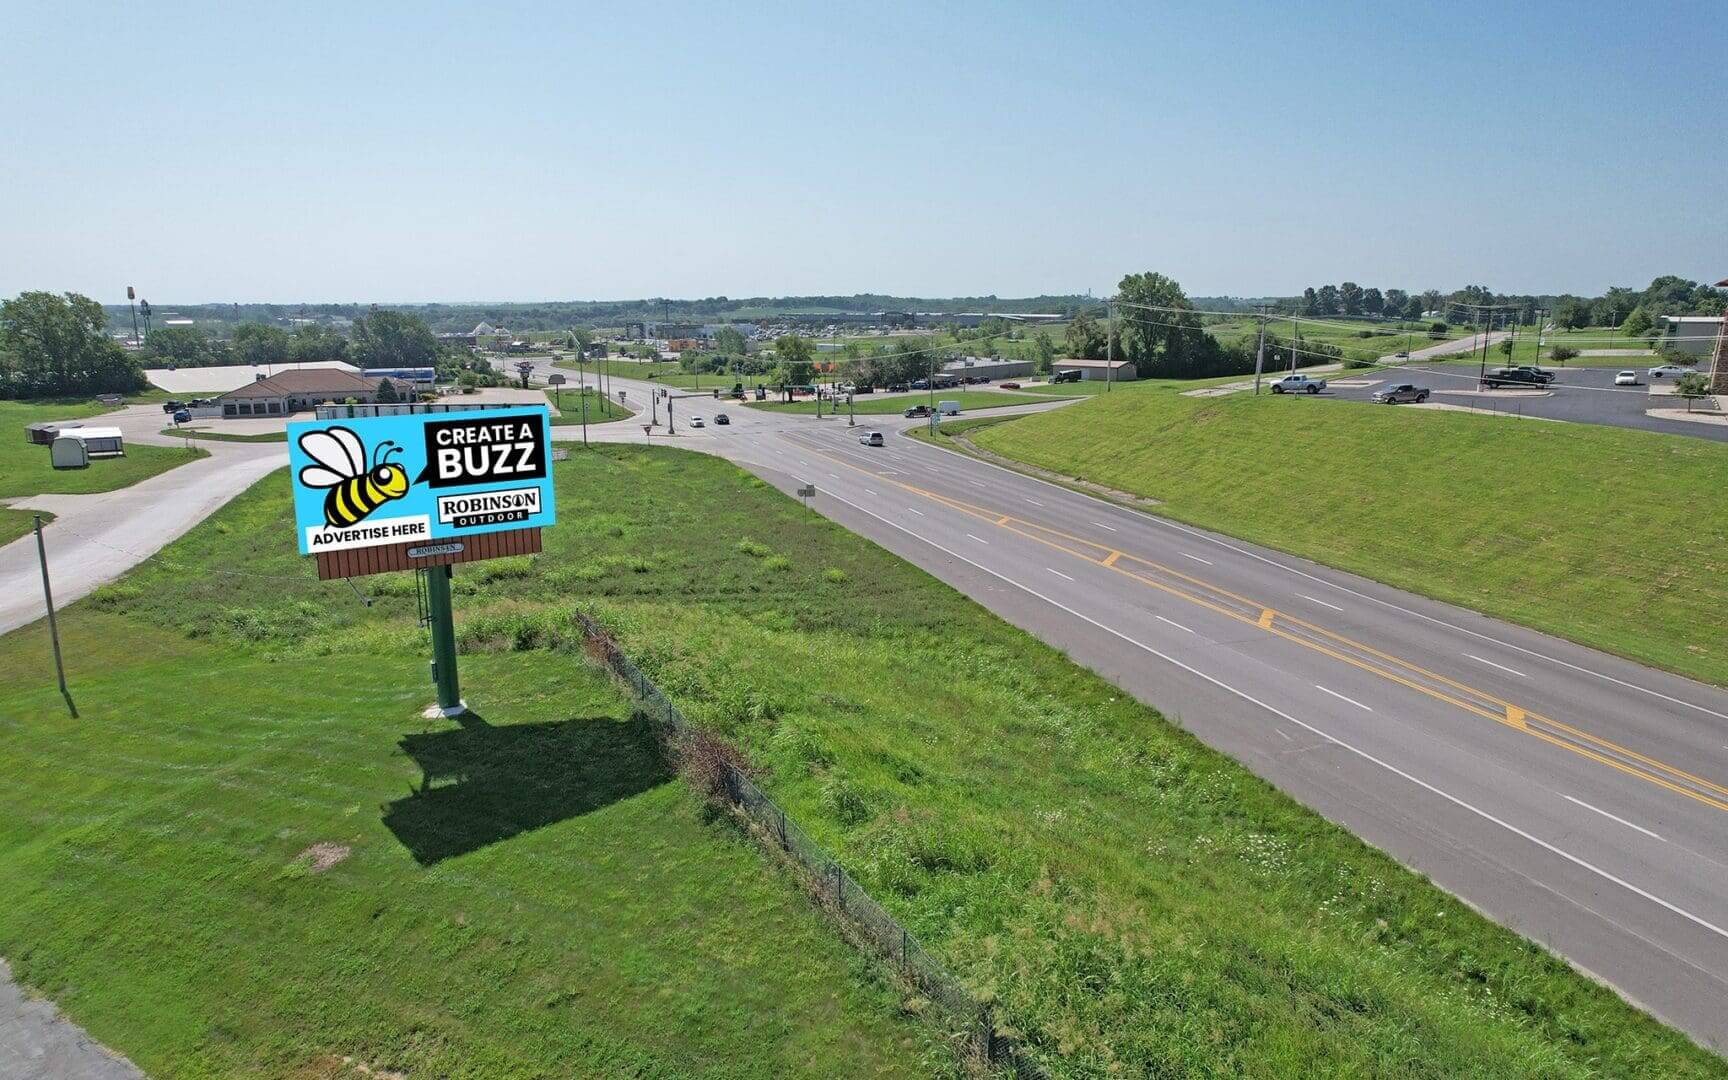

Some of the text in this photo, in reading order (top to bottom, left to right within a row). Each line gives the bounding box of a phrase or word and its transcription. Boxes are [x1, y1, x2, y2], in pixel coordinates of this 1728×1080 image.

[436, 423, 534, 446] CREATE A
[437, 442, 537, 480] BUZZ
[443, 492, 537, 515] ROBINSON
[459, 511, 524, 526] OUTDOOR
[312, 522, 426, 546] ADVERTISE HERE
